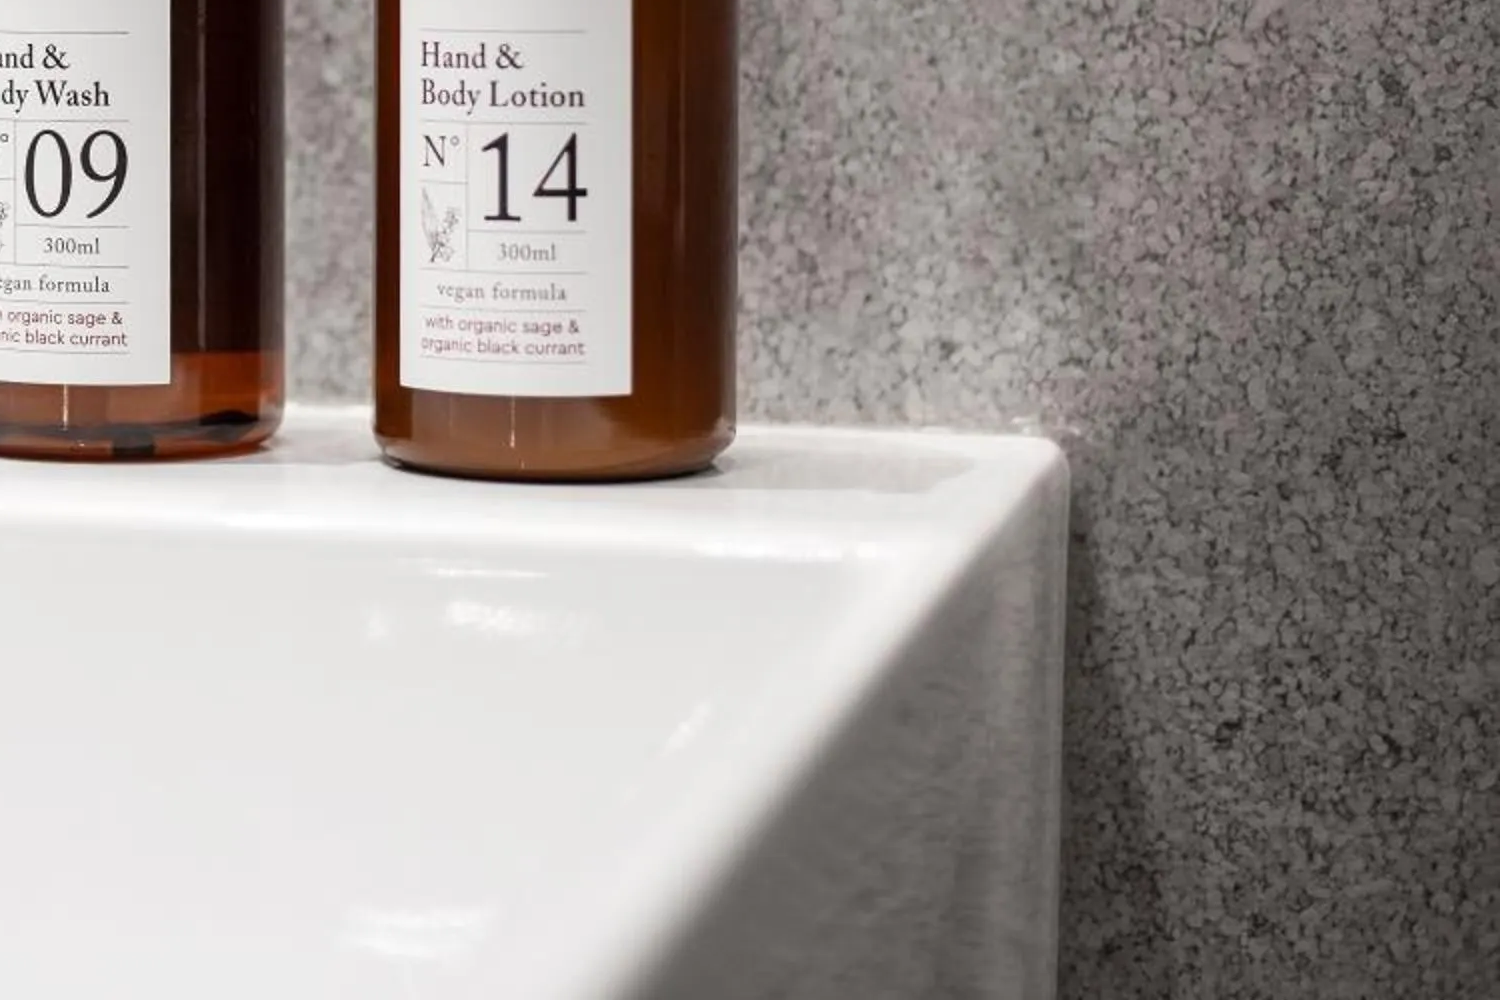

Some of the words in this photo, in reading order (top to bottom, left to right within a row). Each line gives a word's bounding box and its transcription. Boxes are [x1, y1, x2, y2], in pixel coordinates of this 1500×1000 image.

[42, 44, 70, 69] &
[421, 41, 486, 69] Hand
[496, 43, 524, 69] &
[34, 81, 110, 107] Wash
[421, 79, 479, 115] Body
[490, 82, 584, 107] Lotion
[24, 129, 128, 219] 09
[482, 132, 588, 222] 14
[44, 237, 100, 254] 300ml
[498, 243, 557, 261] 300ml
[39, 275, 109, 293] formula
[436, 282, 485, 302] vegan
[492, 283, 566, 302] formula
[8, 310, 63, 326] organic
[68, 310, 106, 328] sage
[111, 311, 123, 325] &
[425, 314, 453, 330] with
[458, 318, 517, 334] organic
[522, 318, 563, 335] sage
[567, 319, 580, 333] &
[25, 328, 64, 345] black
[69, 332, 127, 347] currant
[421, 337, 472, 352] organic
[477, 336, 520, 354] black
[525, 340, 584, 355] currant
